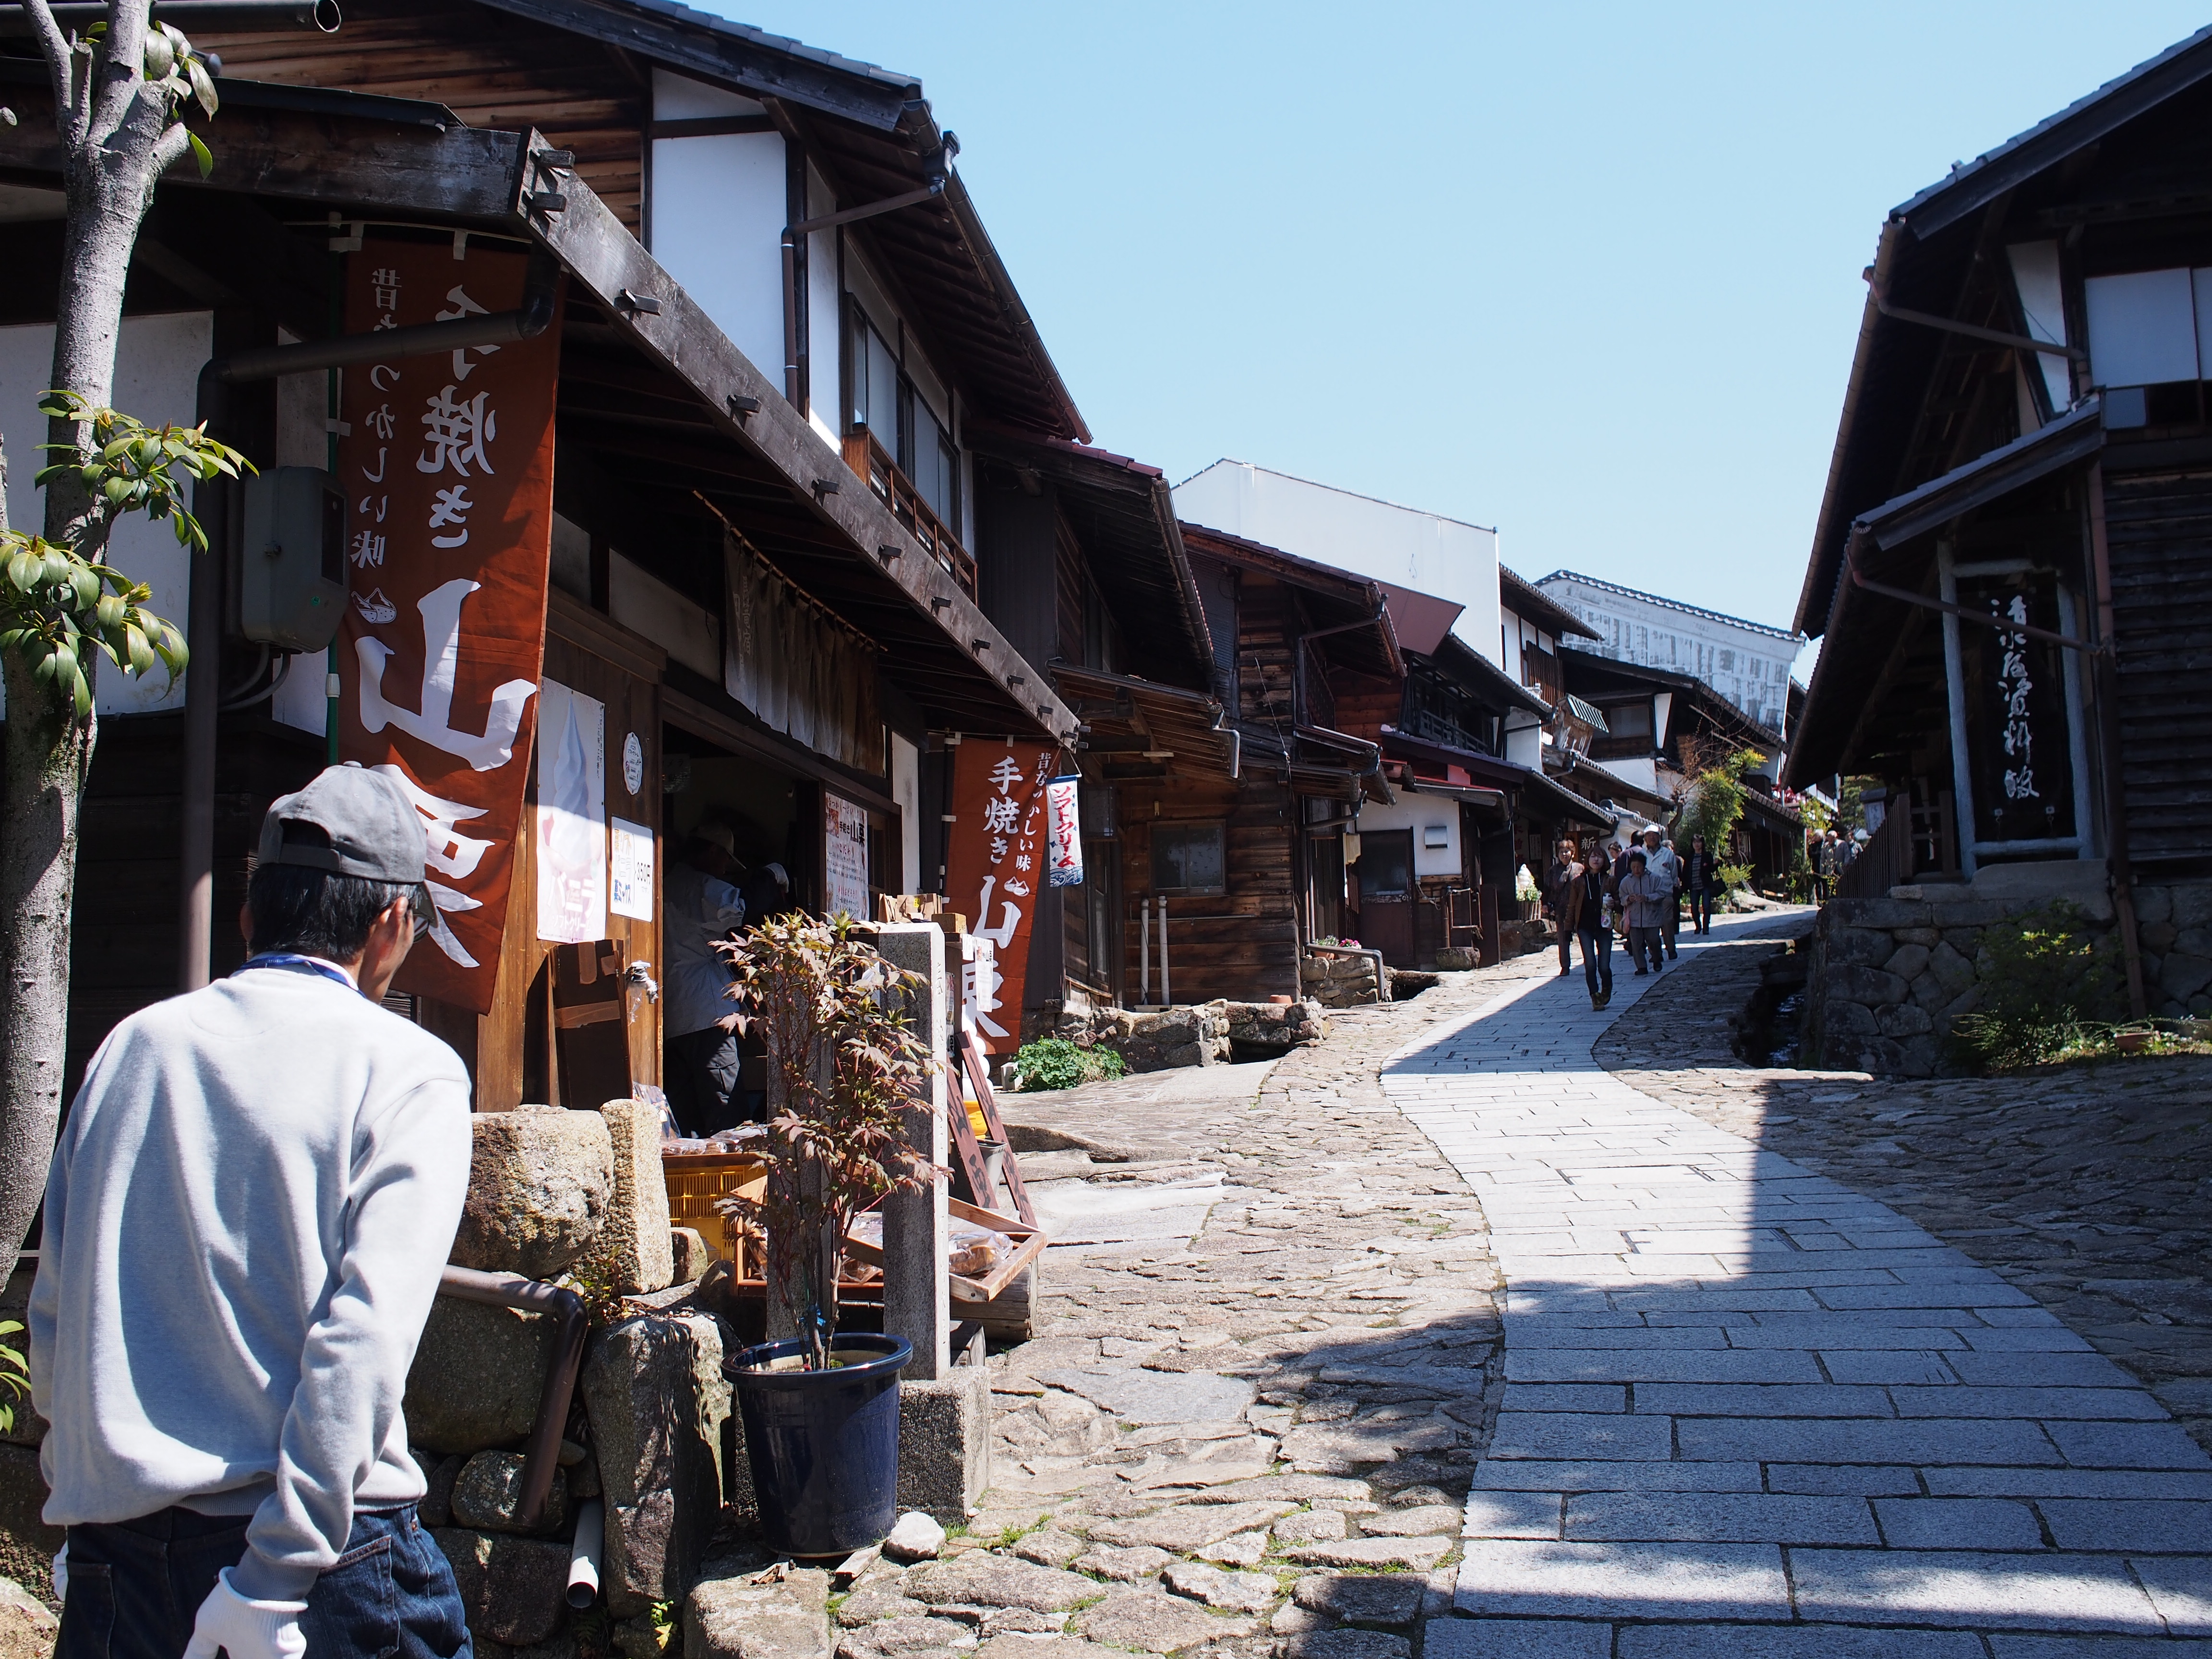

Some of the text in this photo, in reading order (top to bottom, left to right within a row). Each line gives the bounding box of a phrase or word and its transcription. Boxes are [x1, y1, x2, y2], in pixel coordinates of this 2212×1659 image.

[982, 756, 1023, 864] 手焼き
[1016, 752, 1051, 872] 昔なつかしい味
[1052, 786, 1075, 868] ソフトクリーム
[547, 871, 597, 919] バニラ
[637, 861, 650, 885] 350円
[553, 914, 591, 933] ソフトクリーム
